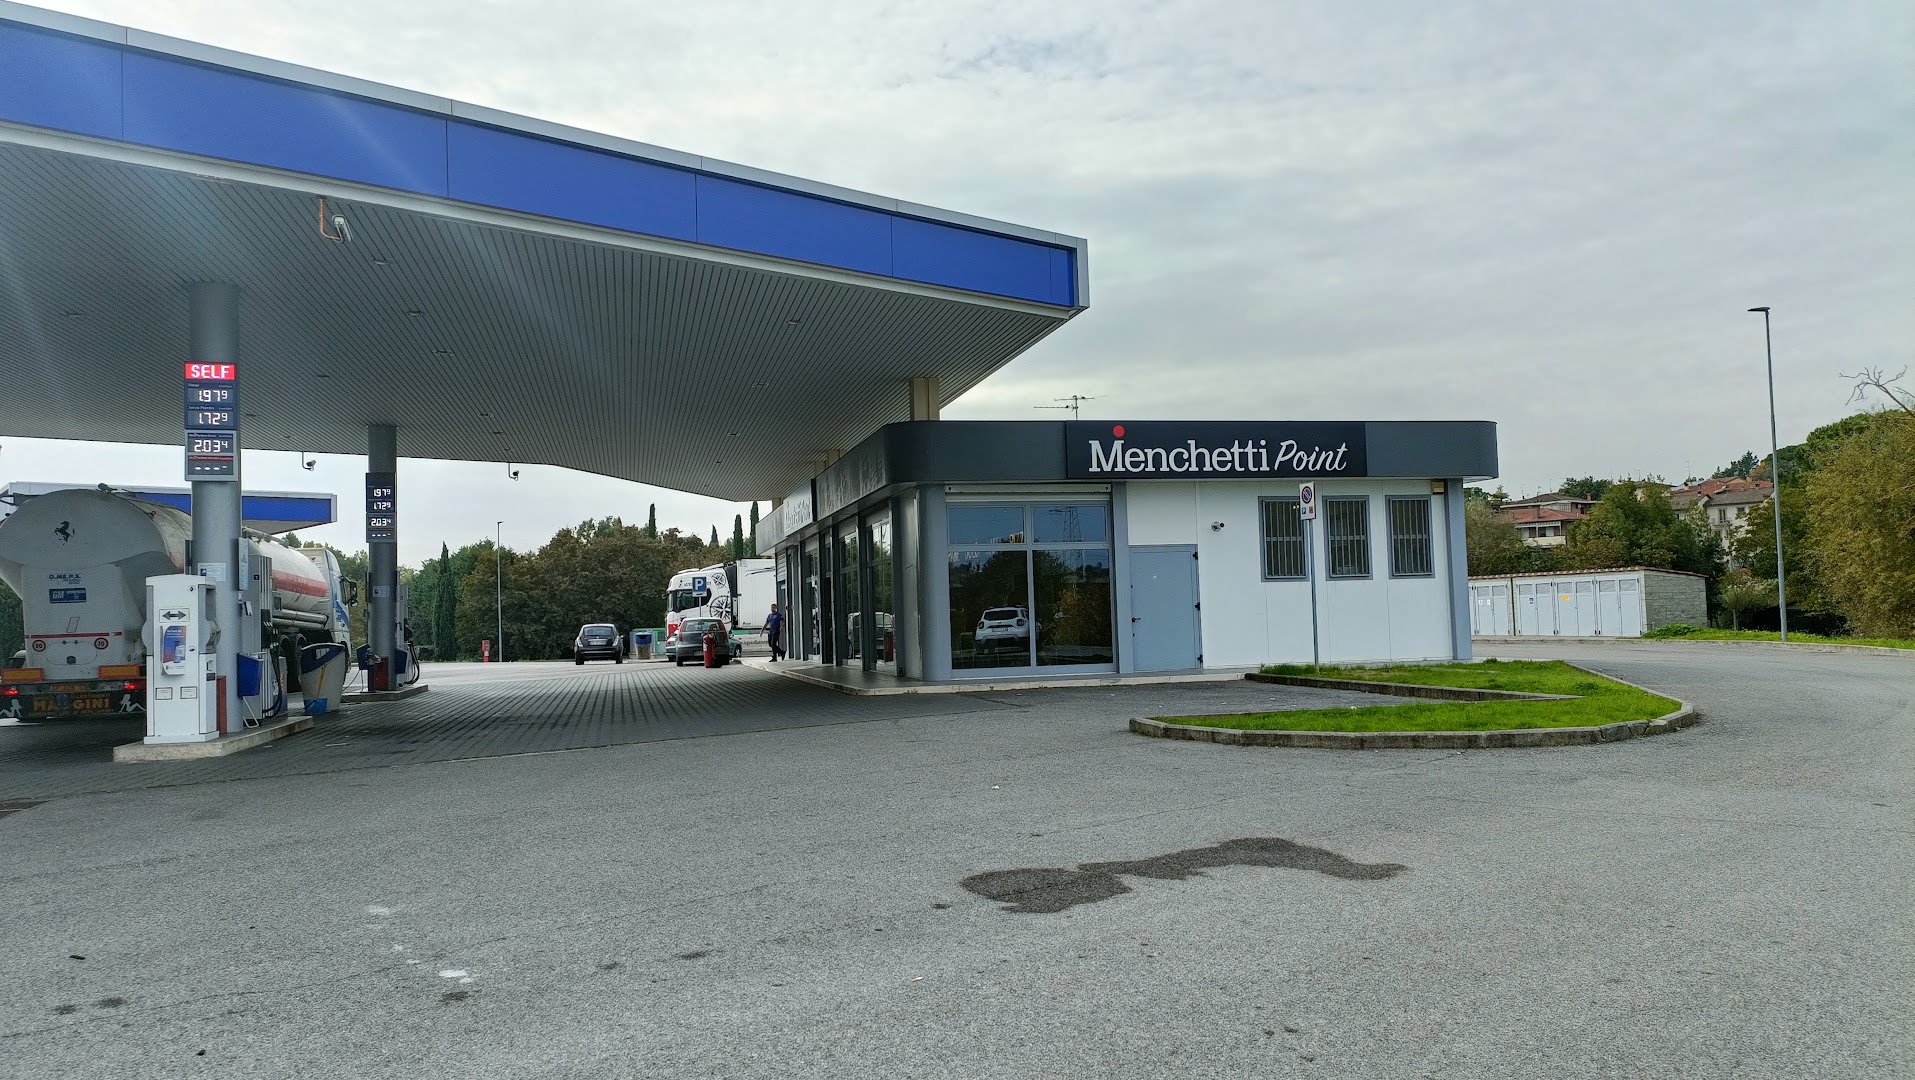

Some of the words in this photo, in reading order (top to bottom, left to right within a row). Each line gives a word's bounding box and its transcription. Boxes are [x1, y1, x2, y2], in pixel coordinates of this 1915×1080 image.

[191, 364, 230, 379] SELF
[1088, 439, 1270, 473] Menchetti
[1274, 439, 1348, 471] Point
[694, 578, 704, 591] P
